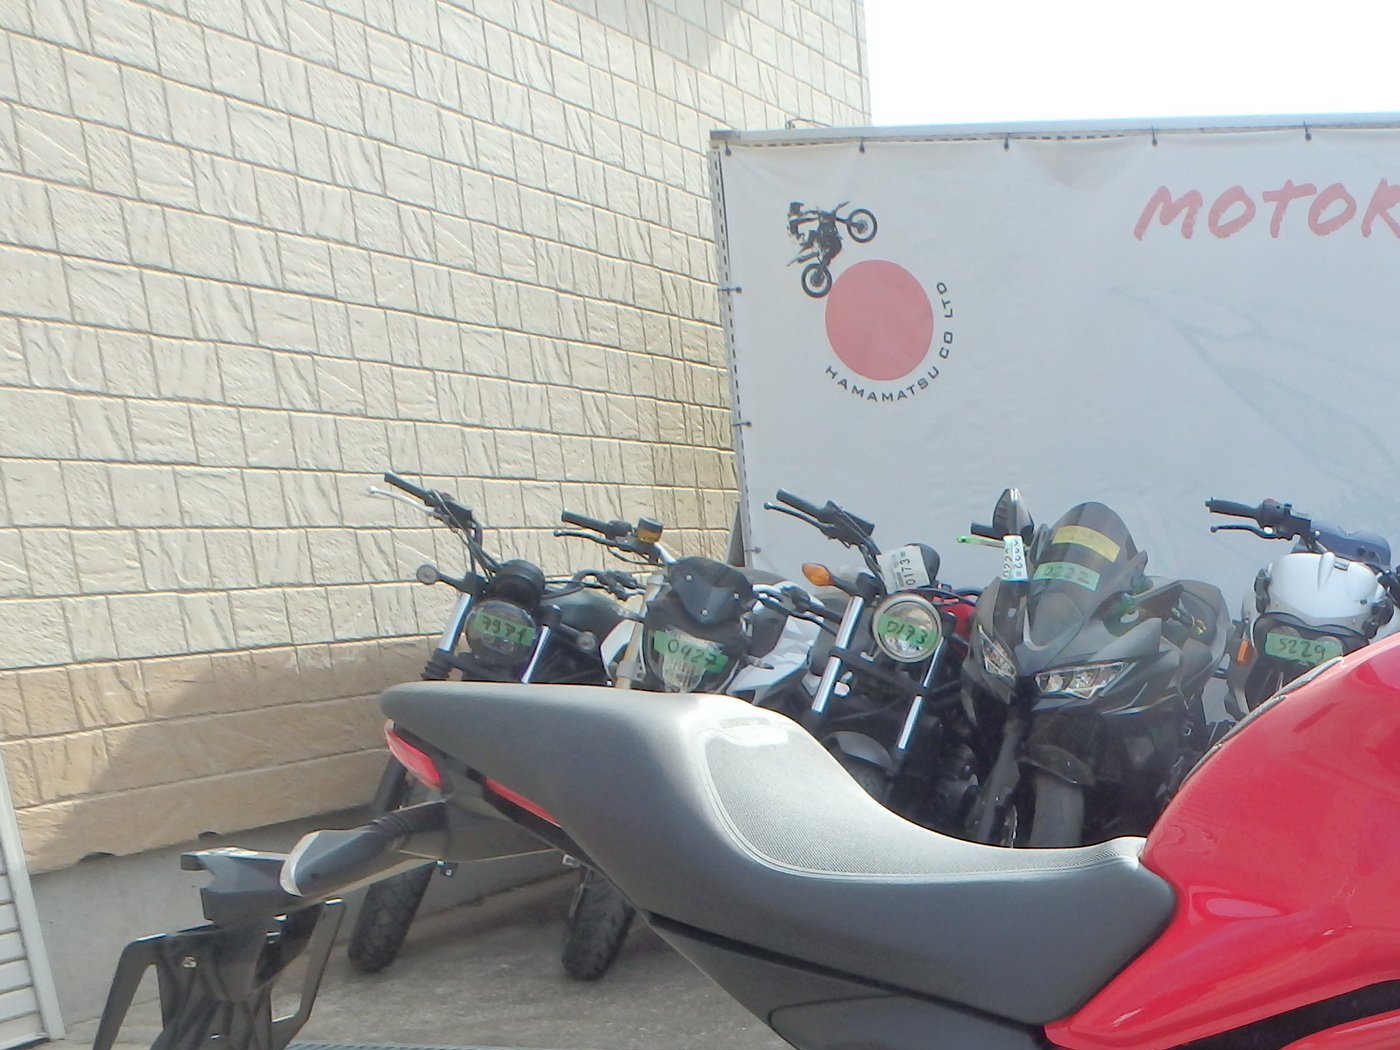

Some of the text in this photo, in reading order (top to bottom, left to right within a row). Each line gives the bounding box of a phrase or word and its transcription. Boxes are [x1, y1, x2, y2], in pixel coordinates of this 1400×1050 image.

[825, 282, 954, 402] HAMAMATSU CO LTD
[900, 558, 917, 586] 0173
